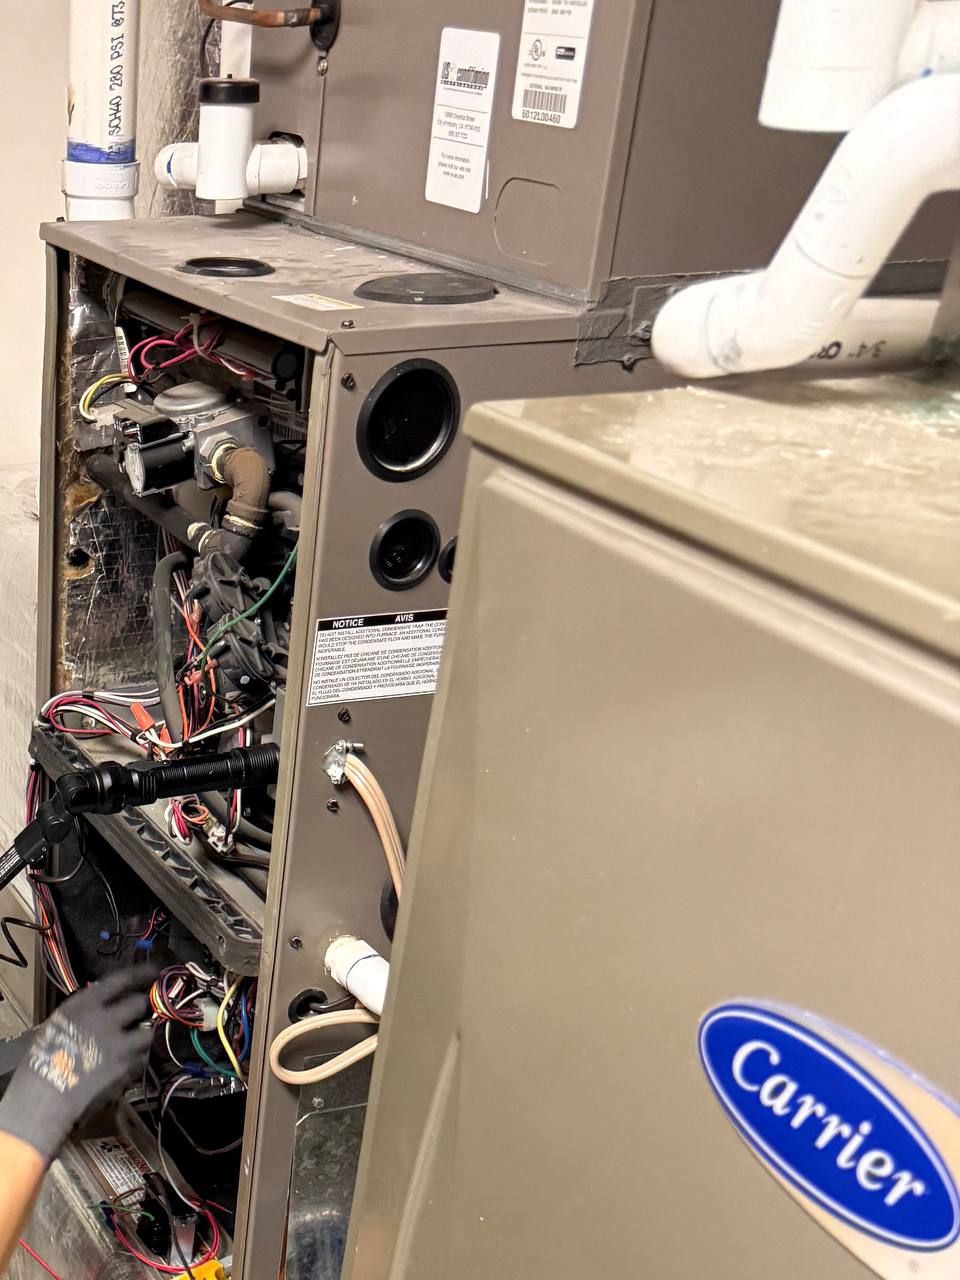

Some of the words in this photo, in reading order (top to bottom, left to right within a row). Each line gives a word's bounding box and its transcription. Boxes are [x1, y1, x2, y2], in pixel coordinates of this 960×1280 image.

[110, 33, 124, 61] PSI
[109, 65, 123, 91] 280
[109, 95, 122, 136] SCH40
[332, 618, 364, 629] NOTICE
[394, 613, 414, 623] AVIS
[732, 1040, 926, 1207] Carrier
